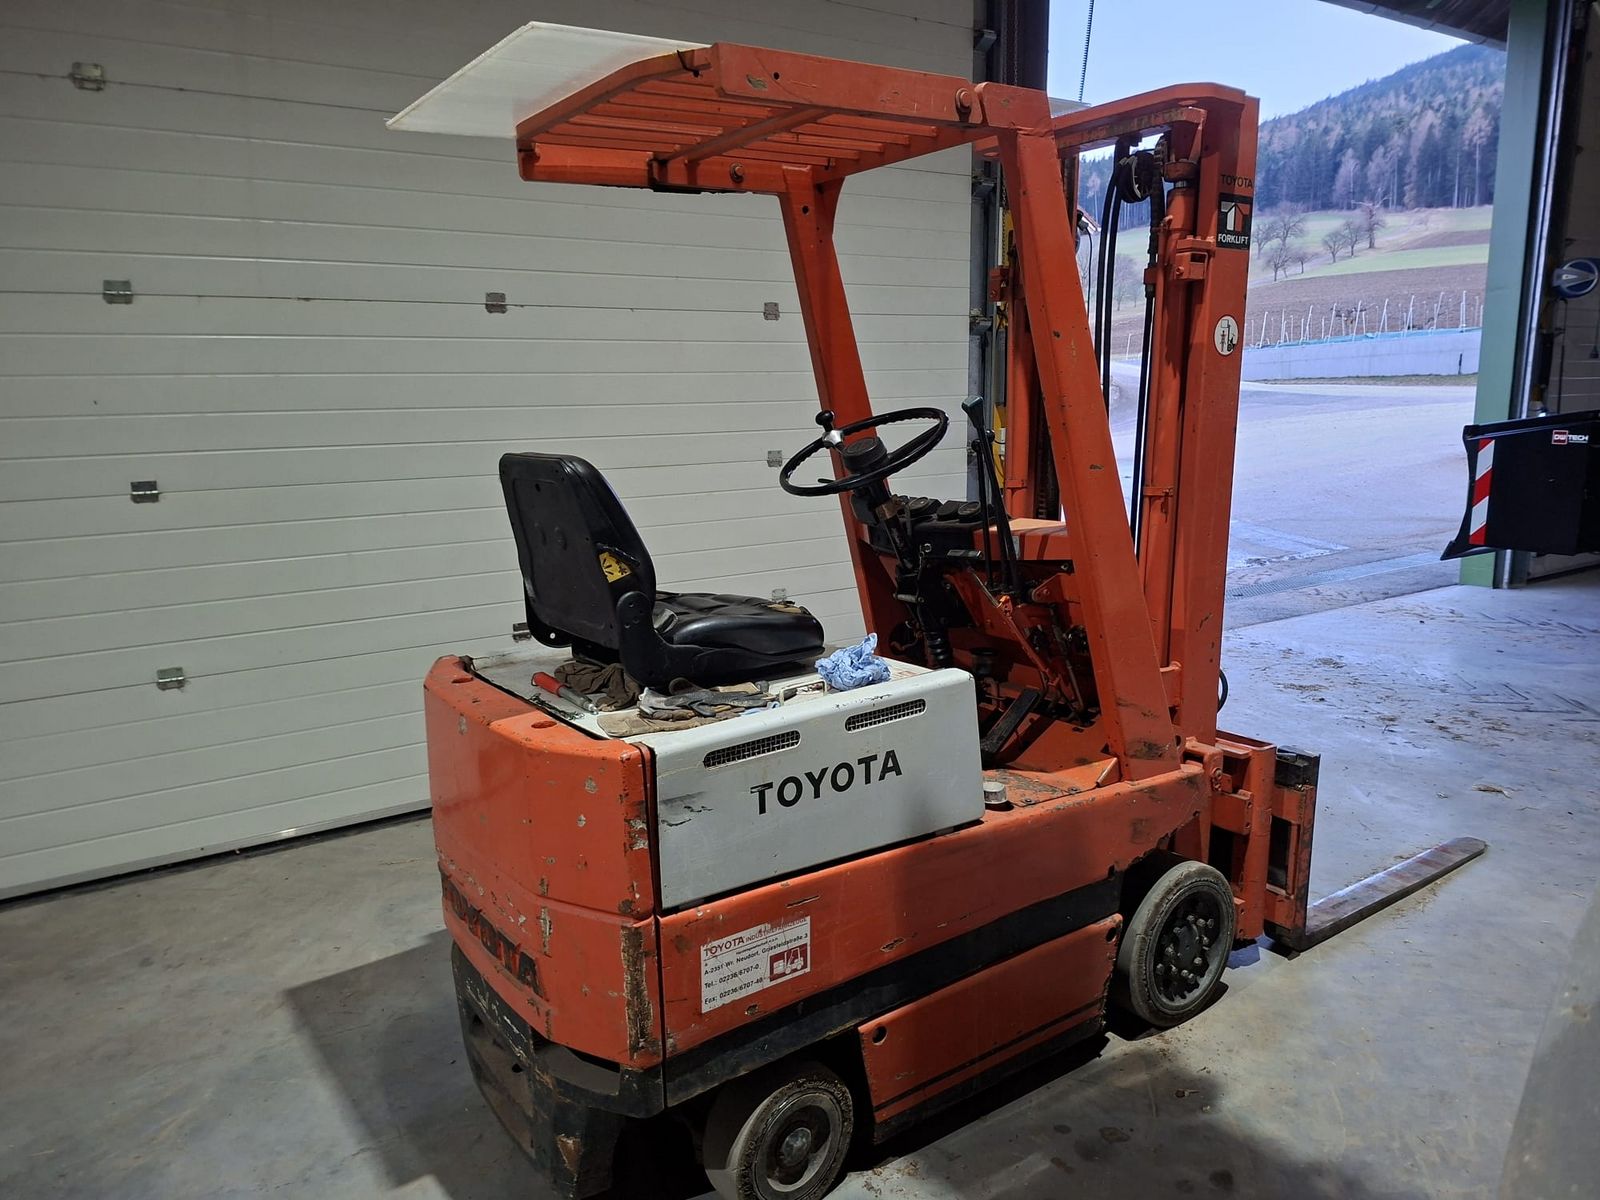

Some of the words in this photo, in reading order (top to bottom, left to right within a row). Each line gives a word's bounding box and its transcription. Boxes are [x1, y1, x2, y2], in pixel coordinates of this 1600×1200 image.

[1221, 174, 1253, 189] TOYOTA
[1217, 233, 1249, 246] FORKLIFT
[750, 749, 903, 815] TOYOTA
[703, 936, 745, 957] TOYOTA
